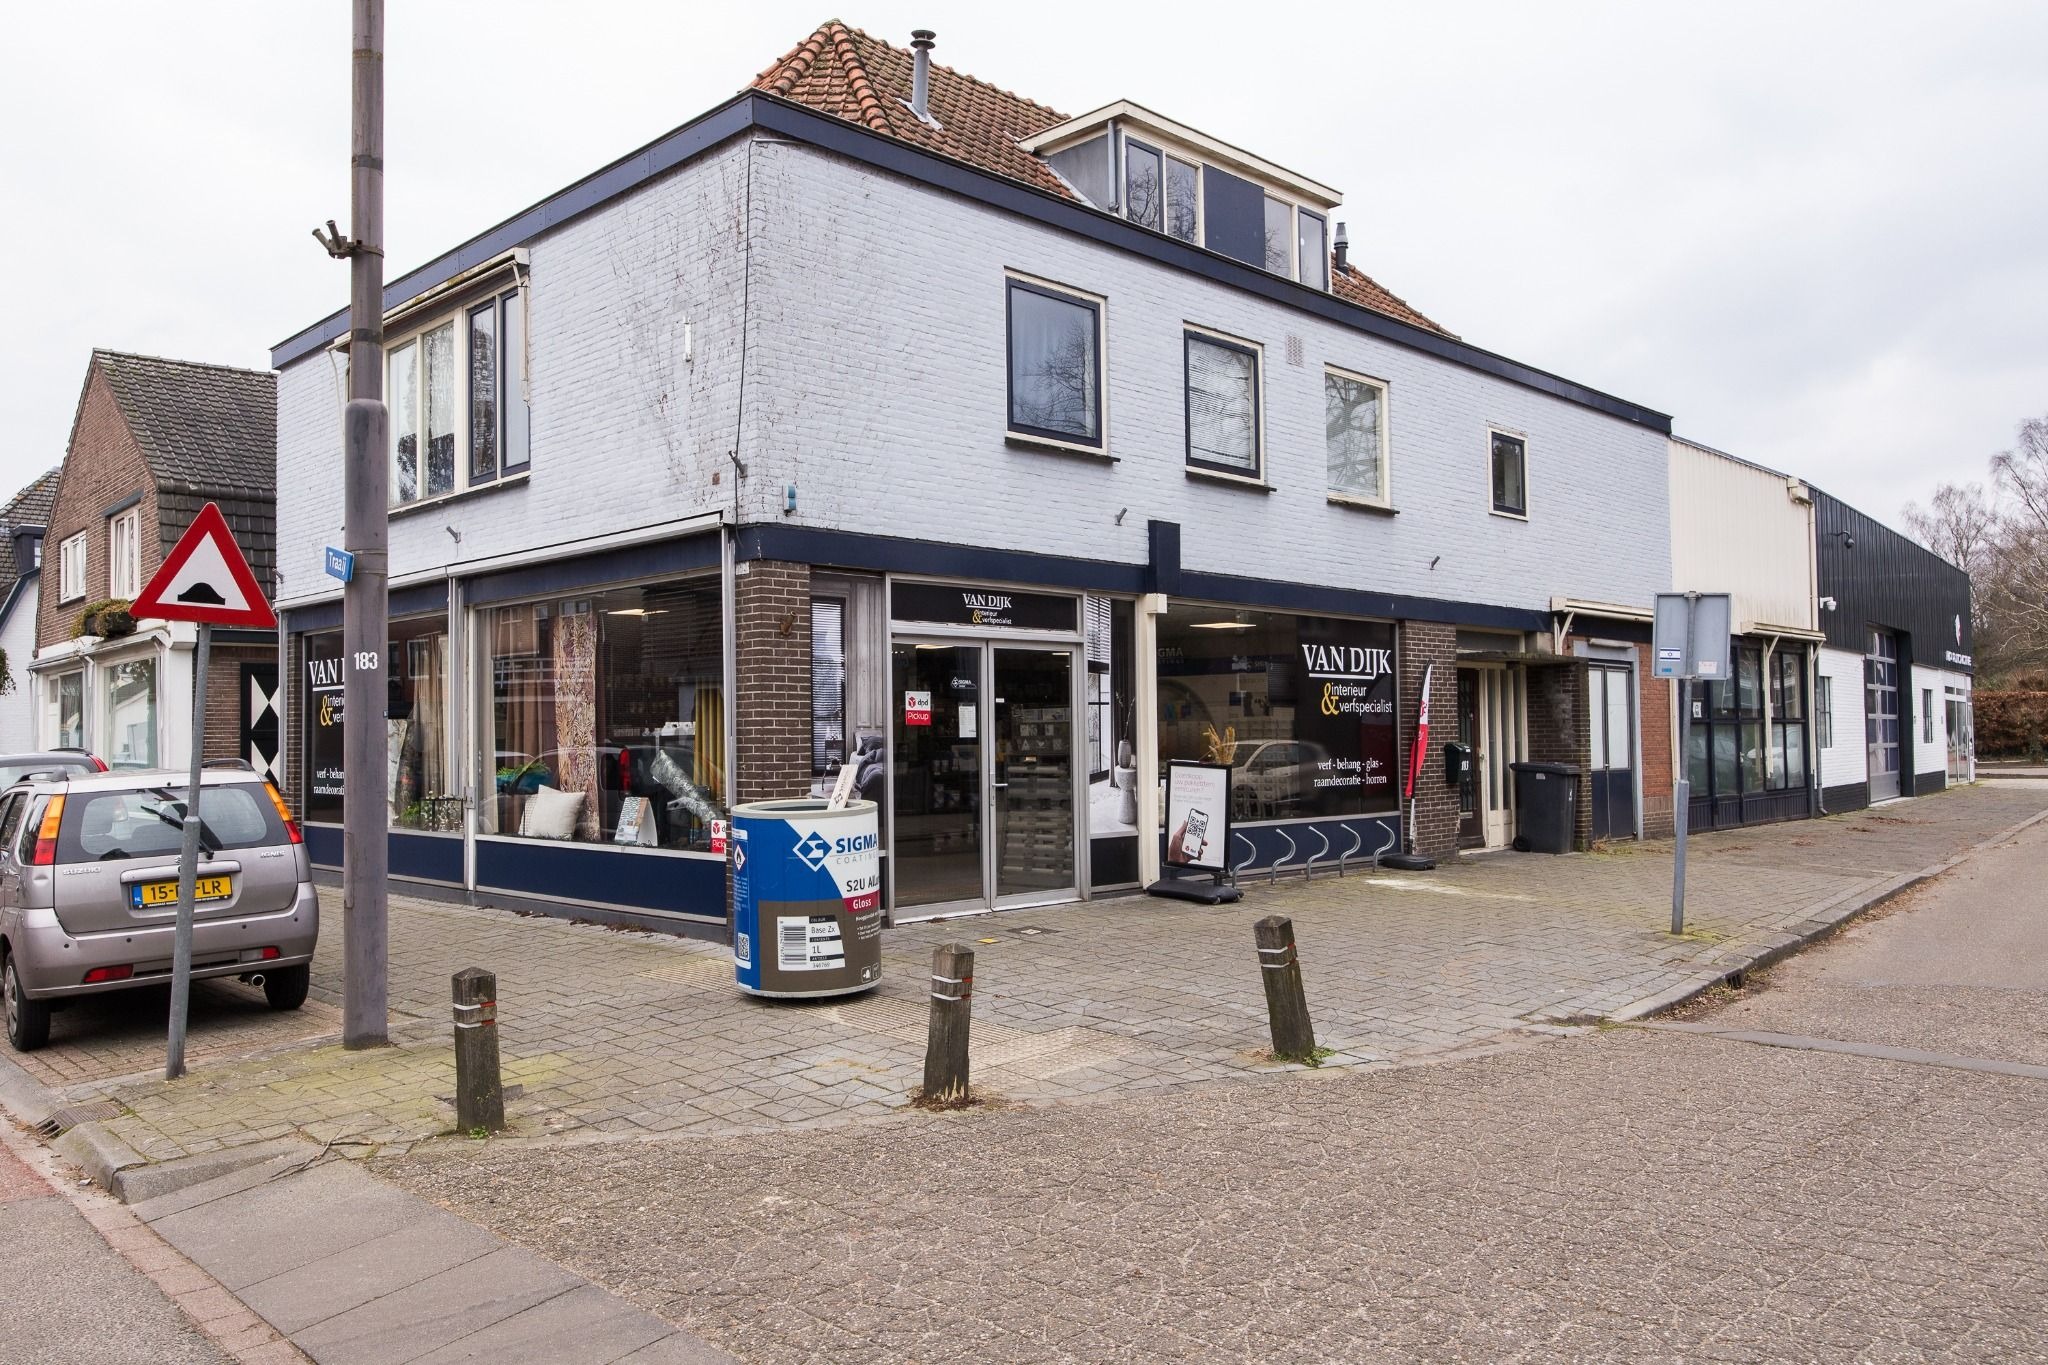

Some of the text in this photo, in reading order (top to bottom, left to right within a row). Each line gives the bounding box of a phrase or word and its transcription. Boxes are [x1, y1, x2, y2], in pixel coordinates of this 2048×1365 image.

[962, 593, 1012, 609] VAN DIJK
[354, 652, 378, 670] 183
[1302, 644, 1392, 680] VAN DIJK
[308, 658, 338, 685] VAN
[1331, 682, 1367, 697] interieur
[327, 694, 344, 707] interi
[917, 699, 929, 707] dpd
[1339, 698, 1393, 716] verfspecialist
[907, 711, 929, 721] Pickup
[1317, 758, 1331, 770] verf
[1337, 757, 1361, 772] behang
[1366, 757, 1379, 772] glas
[1313, 775, 1361, 787] raamdecoratie
[1366, 773, 1387, 785] horren
[835, 833, 878, 854] SIGMA
[846, 878, 866, 892] S2U
[853, 898, 872, 910] Gloss
[811, 926, 826, 934] Base
[812, 945, 822, 954] 1L
